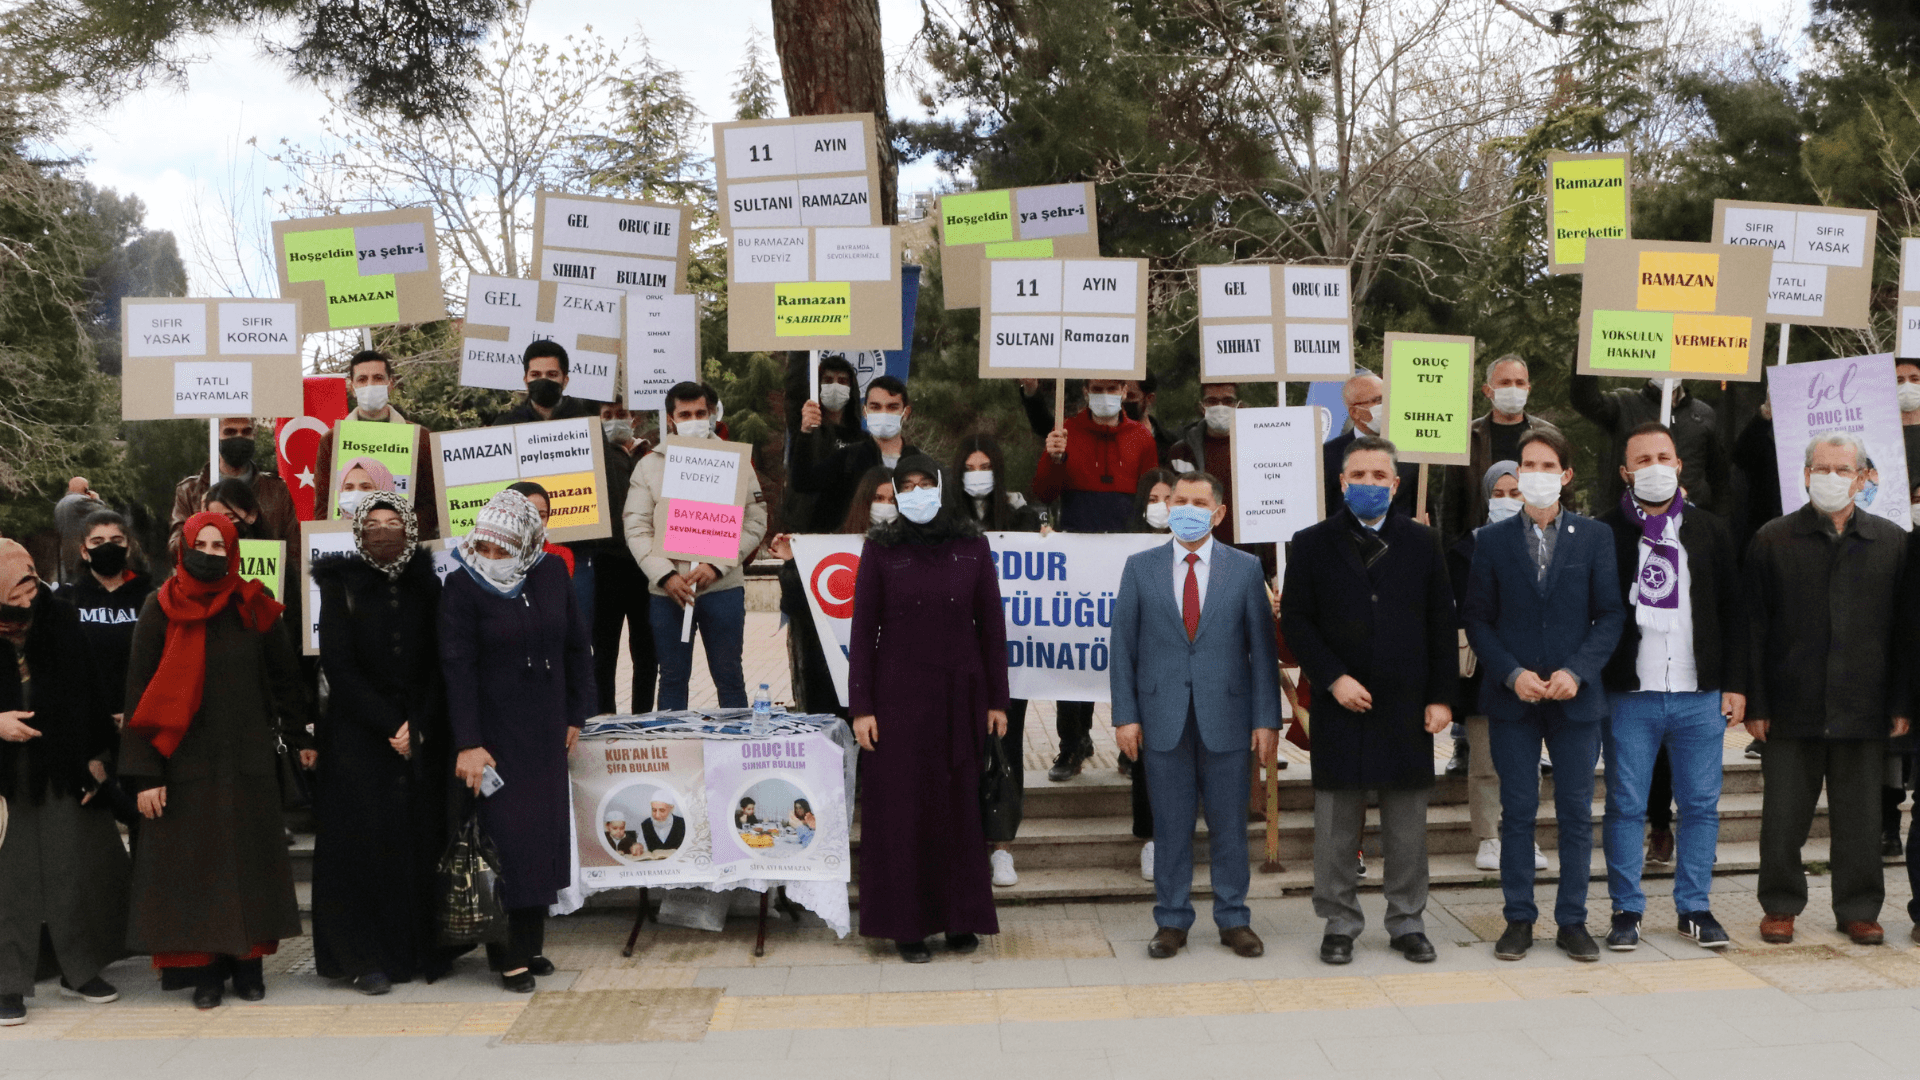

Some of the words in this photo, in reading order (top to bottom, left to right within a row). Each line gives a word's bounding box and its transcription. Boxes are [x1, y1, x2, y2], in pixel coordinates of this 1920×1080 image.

[749, 144, 773, 162] 11
[814, 138, 847, 152] AYIN
[1555, 177, 1623, 190] Ramazan
[734, 196, 793, 212] SULTANI
[802, 192, 868, 208] RAMAZAN
[567, 213, 589, 228] GEL
[618, 218, 651, 236] ORUÇ
[946, 211, 1009, 226] Hoşgeldin
[1020, 211, 1038, 223] ya
[1557, 226, 1624, 239] Berekettir
[1745, 222, 1774, 233] SIFIR
[1816, 226, 1845, 237] SIFIR
[737, 237, 751, 247] BU
[754, 237, 805, 247] RAMAZAN
[1808, 240, 1850, 254] YASAK
[289, 248, 354, 263] Hoşgeldin
[358, 249, 377, 261] ya
[751, 253, 791, 263] EVDEYİZ
[552, 262, 597, 280] SIHHAT
[616, 270, 667, 288] BULALIM
[1642, 272, 1715, 287] RAMAZAN
[1776, 277, 1807, 287] TATLI
[1016, 279, 1040, 297] 11
[1082, 277, 1117, 291] AYIN
[1224, 281, 1248, 296] GEL
[1292, 282, 1321, 298] ORUÇ
[329, 290, 395, 304] RAMAZAN
[484, 291, 521, 307] GEL
[562, 295, 616, 314] ZEKAT
[776, 295, 847, 306] Ramazan
[151, 318, 183, 328] SIFIR
[242, 317, 273, 327] SIFIR
[143, 333, 191, 345] YASAK
[227, 332, 288, 343] KORONA
[996, 332, 1055, 346] SULTANI
[1064, 329, 1130, 343] Ramazan
[1602, 329, 1664, 342] YOKSULUN
[1216, 339, 1262, 354] SIHHAT
[1294, 340, 1341, 354] BULALIM
[1607, 347, 1656, 359] HAKKINI
[1412, 357, 1450, 370] ORUÇ
[196, 377, 229, 387] TATLI
[1417, 374, 1444, 384] TUT
[176, 391, 249, 402] BAYRAMLAR
[1404, 411, 1454, 423] SIHHAT
[1807, 408, 1842, 427] ORUÇ
[527, 429, 589, 445] elimizdekini
[1415, 428, 1442, 439] BUL
[342, 440, 410, 455] Hoşgeldin
[443, 442, 513, 463] RAMAZAN
[669, 454, 683, 463] BU
[685, 455, 735, 469] RAMAZAN
[680, 472, 720, 484] EVDEYİZ
[674, 508, 737, 524] BAYRAMDA
[239, 557, 276, 576] AZAN
[651, 745, 669, 760] İLE
[742, 742, 781, 759] ORUÇ
[785, 740, 805, 757] İLE
[607, 762, 628, 775] ŞİFA
[629, 762, 670, 773] BULALIM
